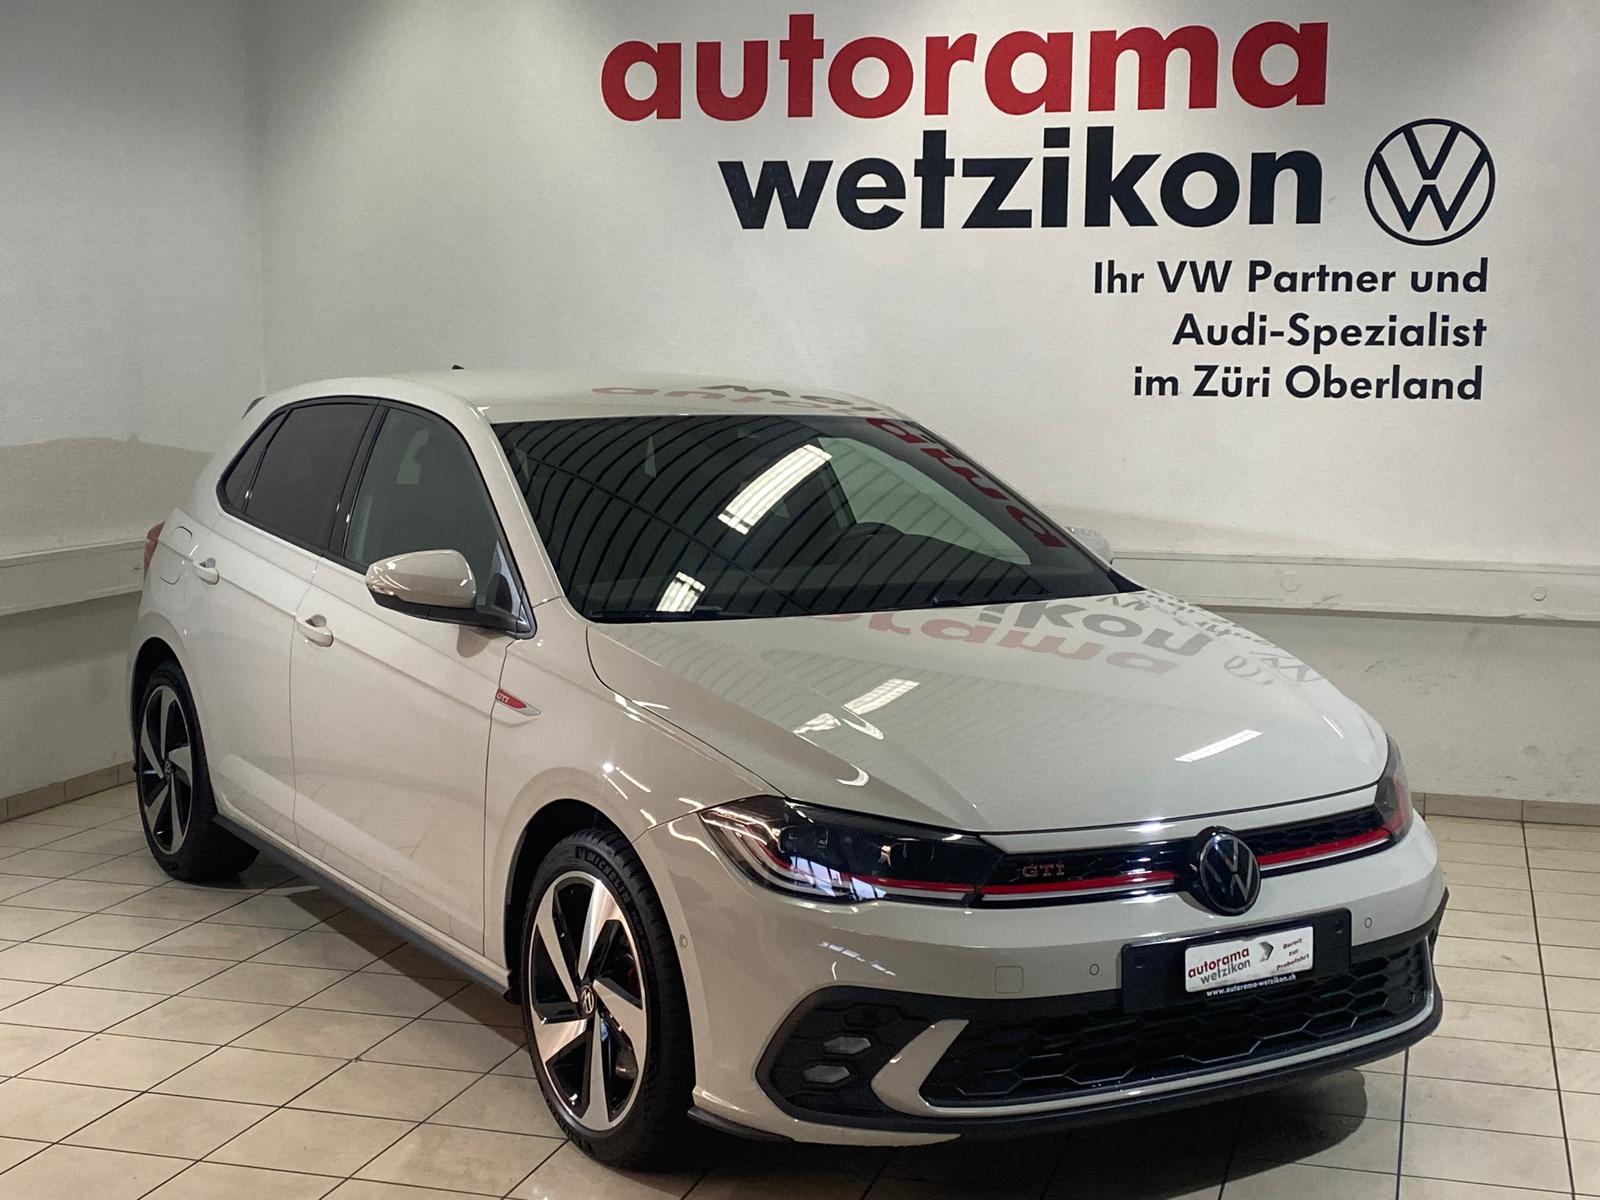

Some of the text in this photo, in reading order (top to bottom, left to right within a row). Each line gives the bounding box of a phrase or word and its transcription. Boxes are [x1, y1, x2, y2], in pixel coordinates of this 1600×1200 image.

[602, 14, 1328, 121] autorama
[718, 126, 1322, 230] wetzikon
[1095, 257, 1488, 294] Ihr VW Partner und
[1172, 312, 1487, 355] Audi-Spezialist
[1135, 364, 1482, 400] im Züri Oberland
[1021, 861, 1066, 879] GTI
[1188, 947, 1250, 978] autorama
[1200, 959, 1251, 985] wetzikon
[1206, 973, 1297, 997] www.autorama-wetzikon.ch
